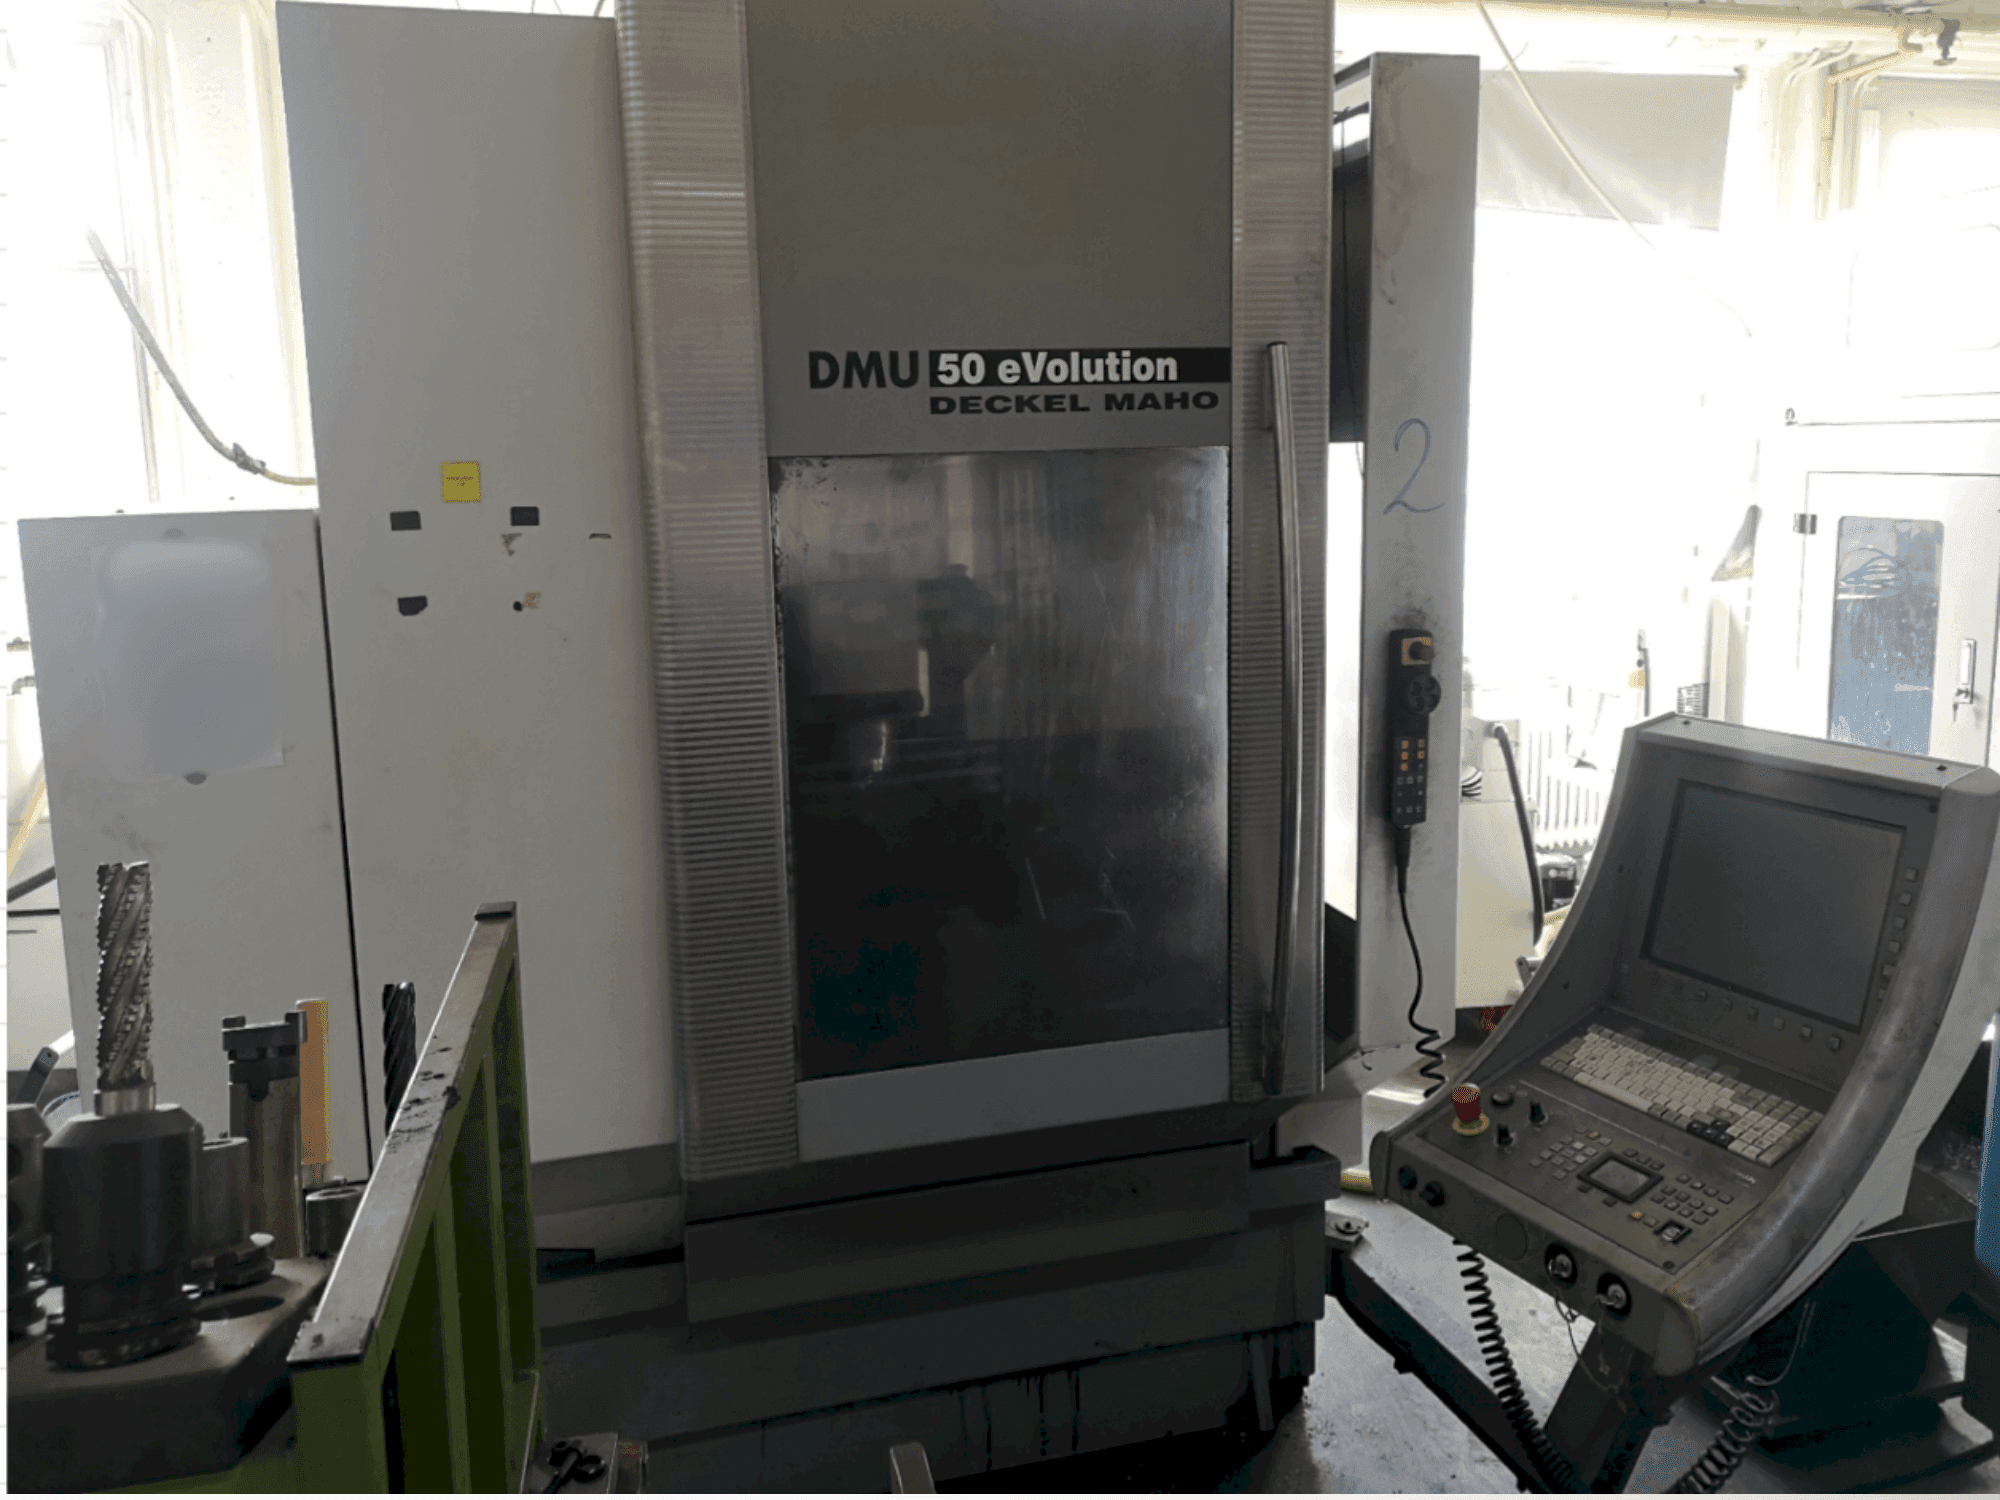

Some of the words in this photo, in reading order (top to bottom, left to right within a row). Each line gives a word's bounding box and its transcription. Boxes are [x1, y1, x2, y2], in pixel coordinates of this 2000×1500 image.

[808, 349, 919, 389] DMU
[937, 352, 986, 385] 50
[997, 350, 1178, 385] eVolution
[929, 394, 1091, 415] DECKEL
[1104, 391, 1219, 412] MAHO
[1382, 417, 1445, 516] 2
